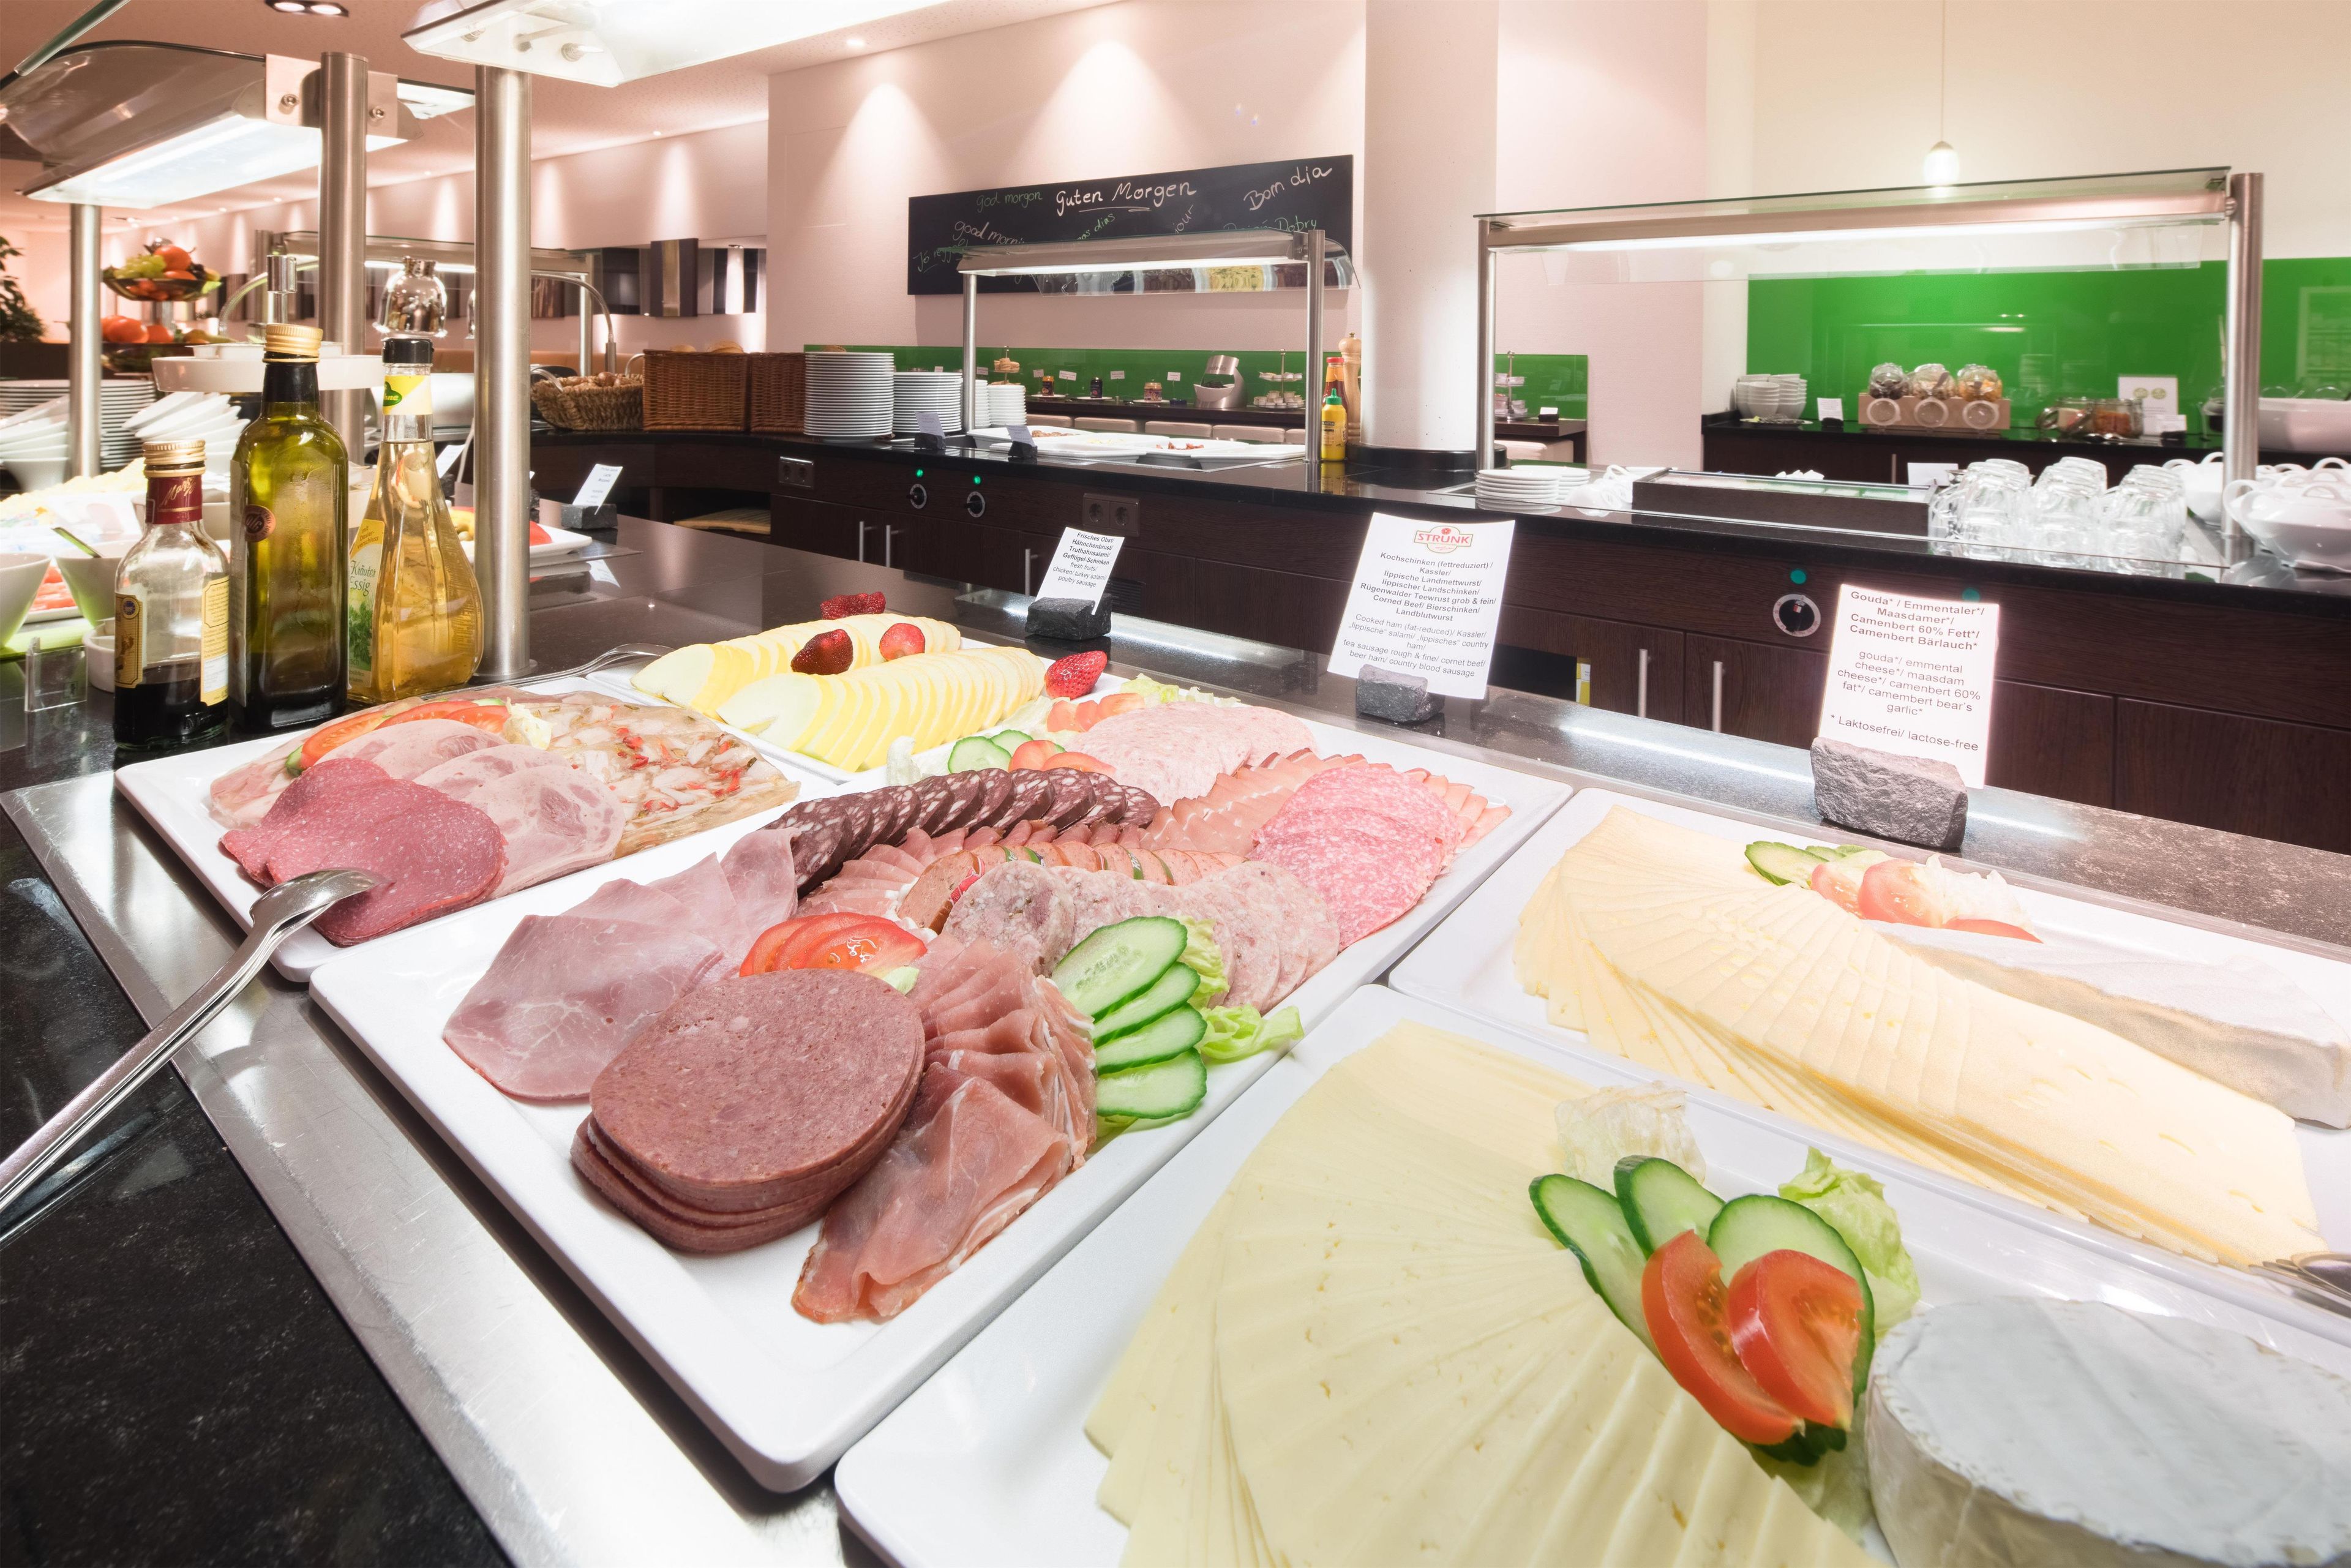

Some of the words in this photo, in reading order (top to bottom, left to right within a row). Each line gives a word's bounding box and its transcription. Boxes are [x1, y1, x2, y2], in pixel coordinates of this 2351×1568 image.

[1243, 181, 1284, 211] Bom
[1291, 166, 1332, 187] dia
[976, 191, 999, 213] god
[1005, 189, 1043, 209] morgon
[1056, 190, 1104, 217] Guten
[1111, 182, 1197, 208] Morgen
[952, 221, 990, 241] good
[1072, 539, 1114, 550] Hähnchenbrust/
[1077, 532, 1100, 541] Frisches
[1417, 533, 1470, 544] STRUNK
[1063, 552, 1109, 565] Geflügel-Schinken
[1380, 552, 1435, 566] Kochschinken
[1438, 561, 1488, 569] (fettreduziert)
[1058, 576, 1075, 584] poultry
[1384, 570, 1419, 582] lippische
[1421, 576, 1482, 587] Landmettwurst/
[1419, 567, 1451, 576] Kassler/
[1360, 582, 1412, 598] Rügenwalder
[1382, 579, 1420, 590] lippischer
[1422, 585, 1480, 595] Landschinken/
[1373, 595, 1402, 605] Corned
[1426, 603, 1480, 613] Bierschinken/
[1396, 608, 1453, 621] Landblutwurst
[1355, 613, 1384, 625] Cooked
[1386, 620, 1402, 629] ham
[1404, 623, 1455, 636] (fat-reduced)/
[1457, 629, 1487, 638] Kassler/
[1851, 613, 1915, 632] Camenbert
[1918, 625, 1943, 636] 60%
[1388, 631, 1415, 639] salami/
[1462, 640, 1489, 649] country
[1850, 625, 1914, 643] Camenbert
[1343, 639, 1355, 647] tea
[1357, 643, 1389, 655] sausage
[1390, 649, 1412, 658] rough
[1422, 653, 1439, 662] fine/
[1441, 658, 1466, 666] cornet
[1406, 642, 1426, 650] ham/
[1349, 650, 1367, 659] beer
[1368, 654, 1388, 663] ham/
[1389, 658, 1417, 670] country
[1419, 662, 1441, 672] blood
[1442, 667, 1475, 678] sausage
[1905, 659, 1963, 673] emmental
[1907, 672, 1964, 686] maasdam
[1869, 688, 1932, 706] camembert
[1889, 680, 1951, 697] camenbert
[1954, 689, 1981, 700] 60%
[1839, 716, 1905, 738] Laktosefrei/
[1908, 730, 1979, 751] lactose-free
